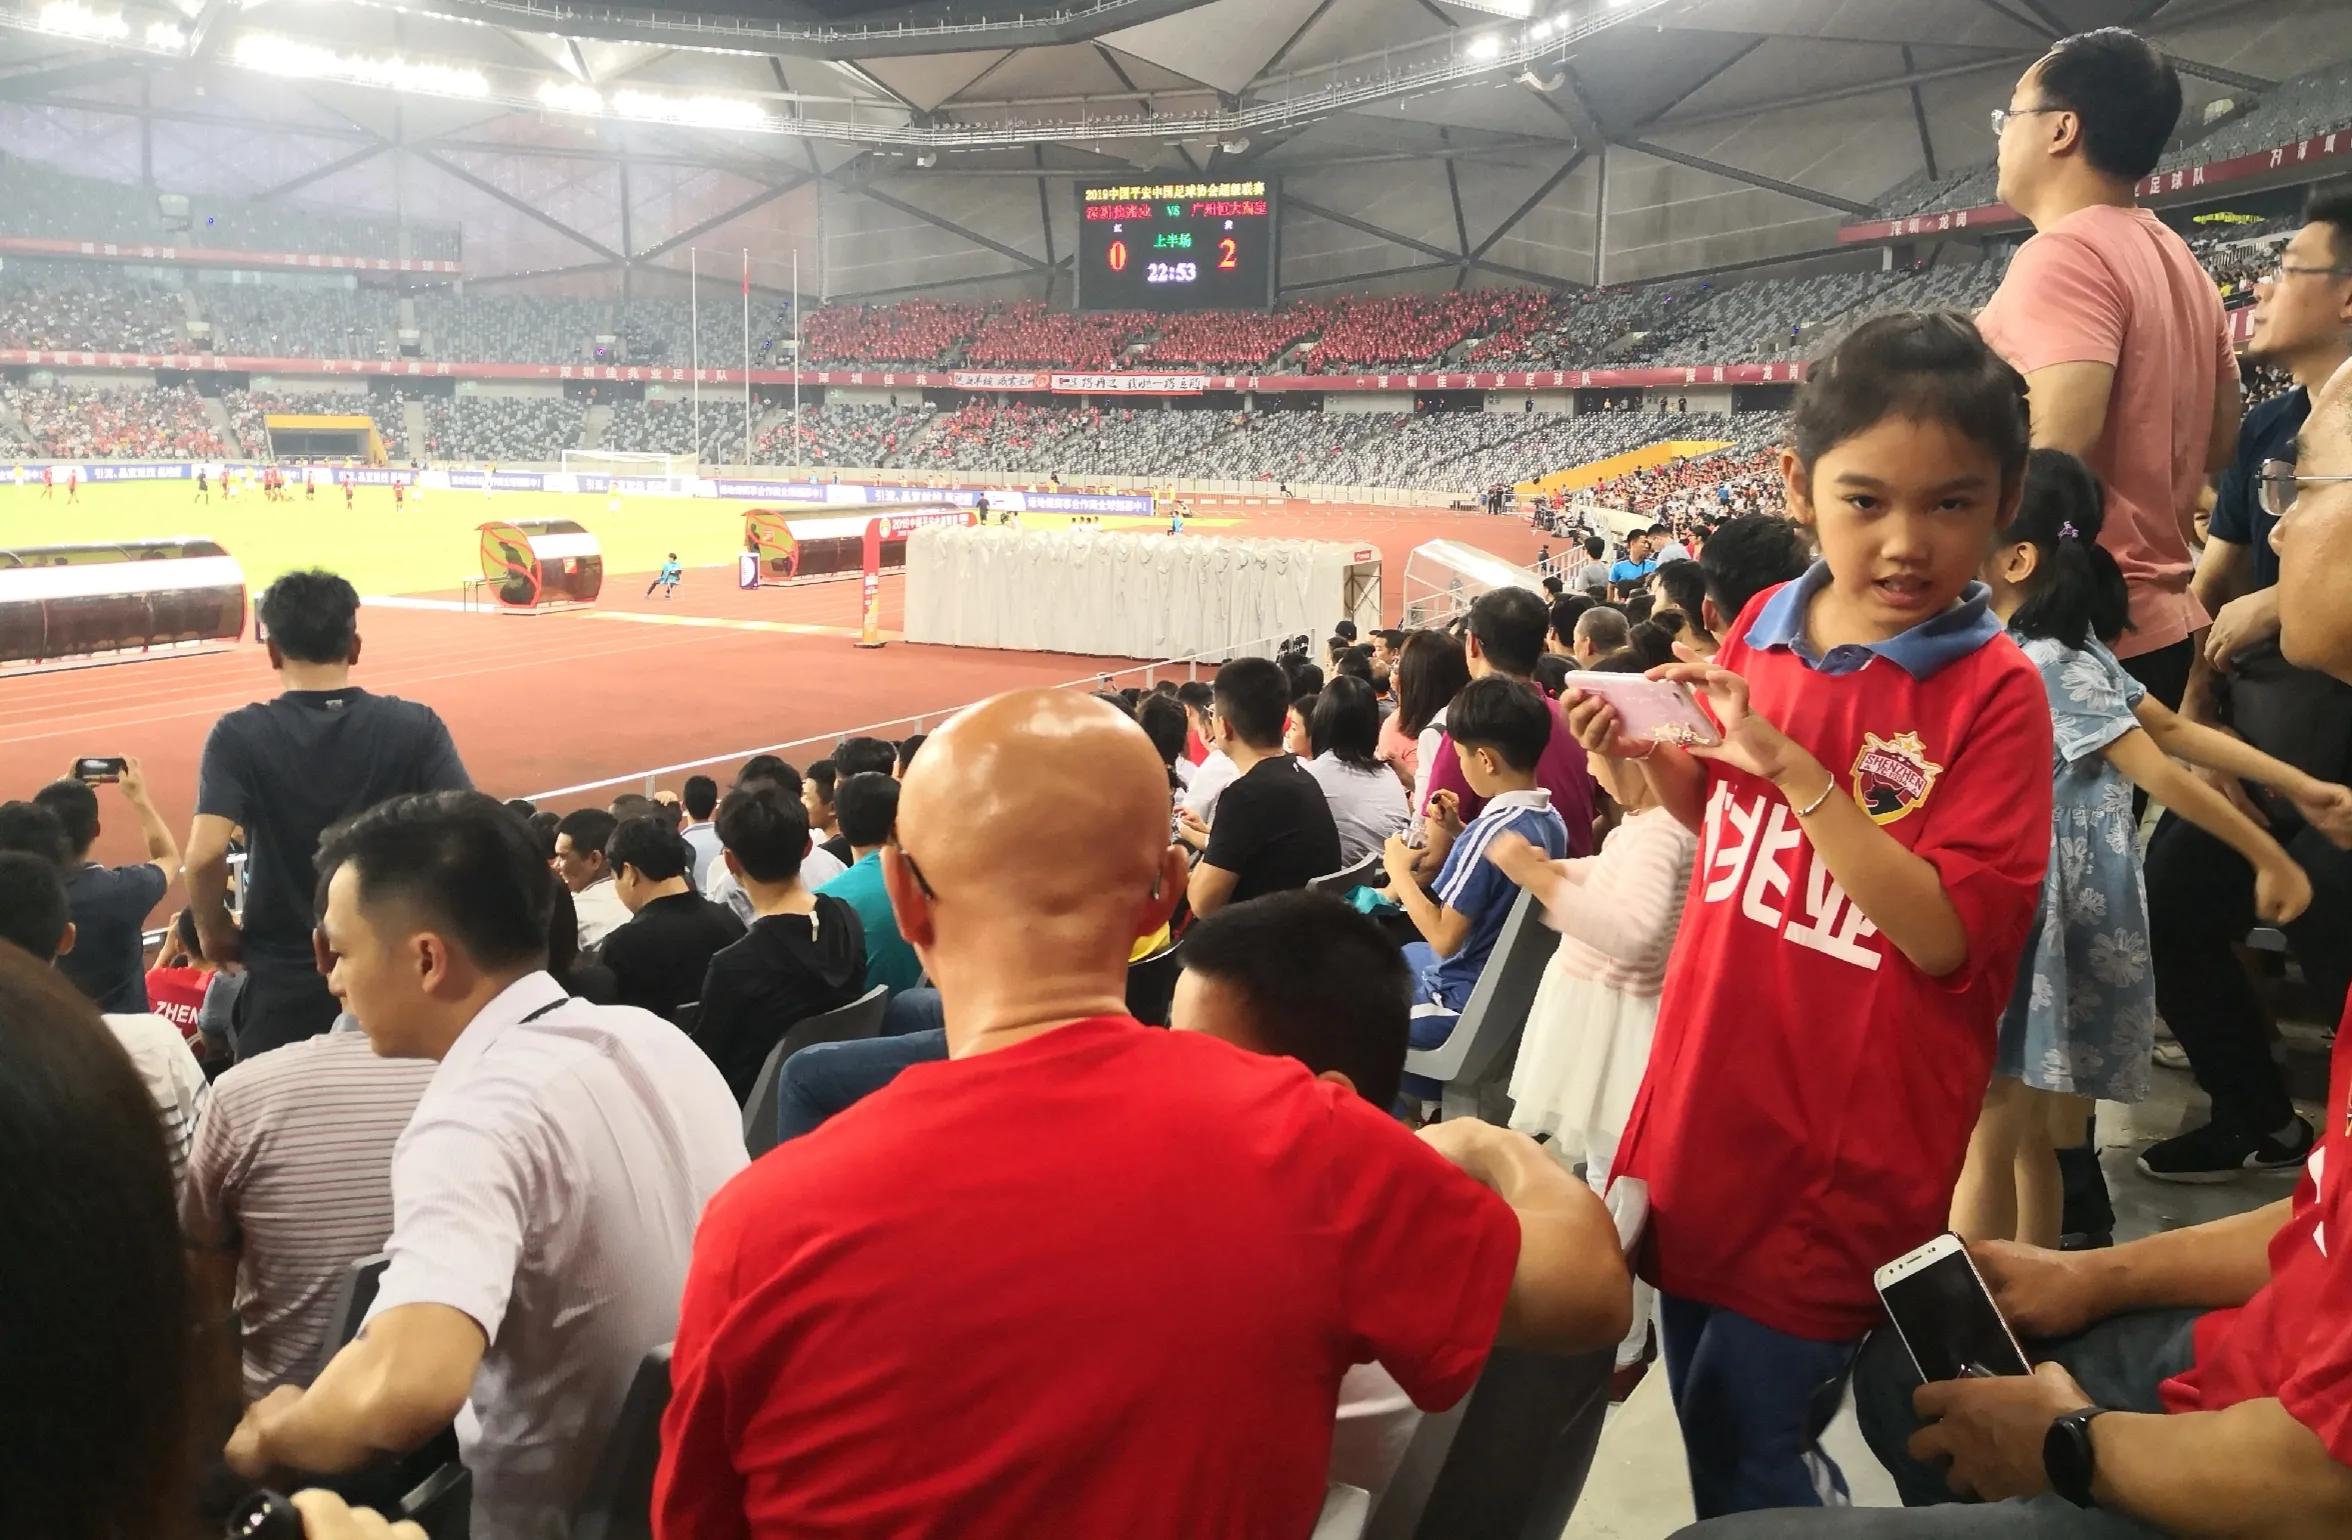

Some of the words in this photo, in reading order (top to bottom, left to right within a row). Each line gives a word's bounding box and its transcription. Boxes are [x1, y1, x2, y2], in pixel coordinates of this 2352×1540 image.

[1166, 205, 1181, 217] VS
[1153, 233, 1192, 248] 上半场
[1109, 241, 1127, 271] 0
[1217, 237, 1237, 268] 2
[1147, 262, 1197, 283] 22:53
[818, 371, 953, 386] 深圳佳兆
[1865, 754, 1924, 790] SHENZHEN
